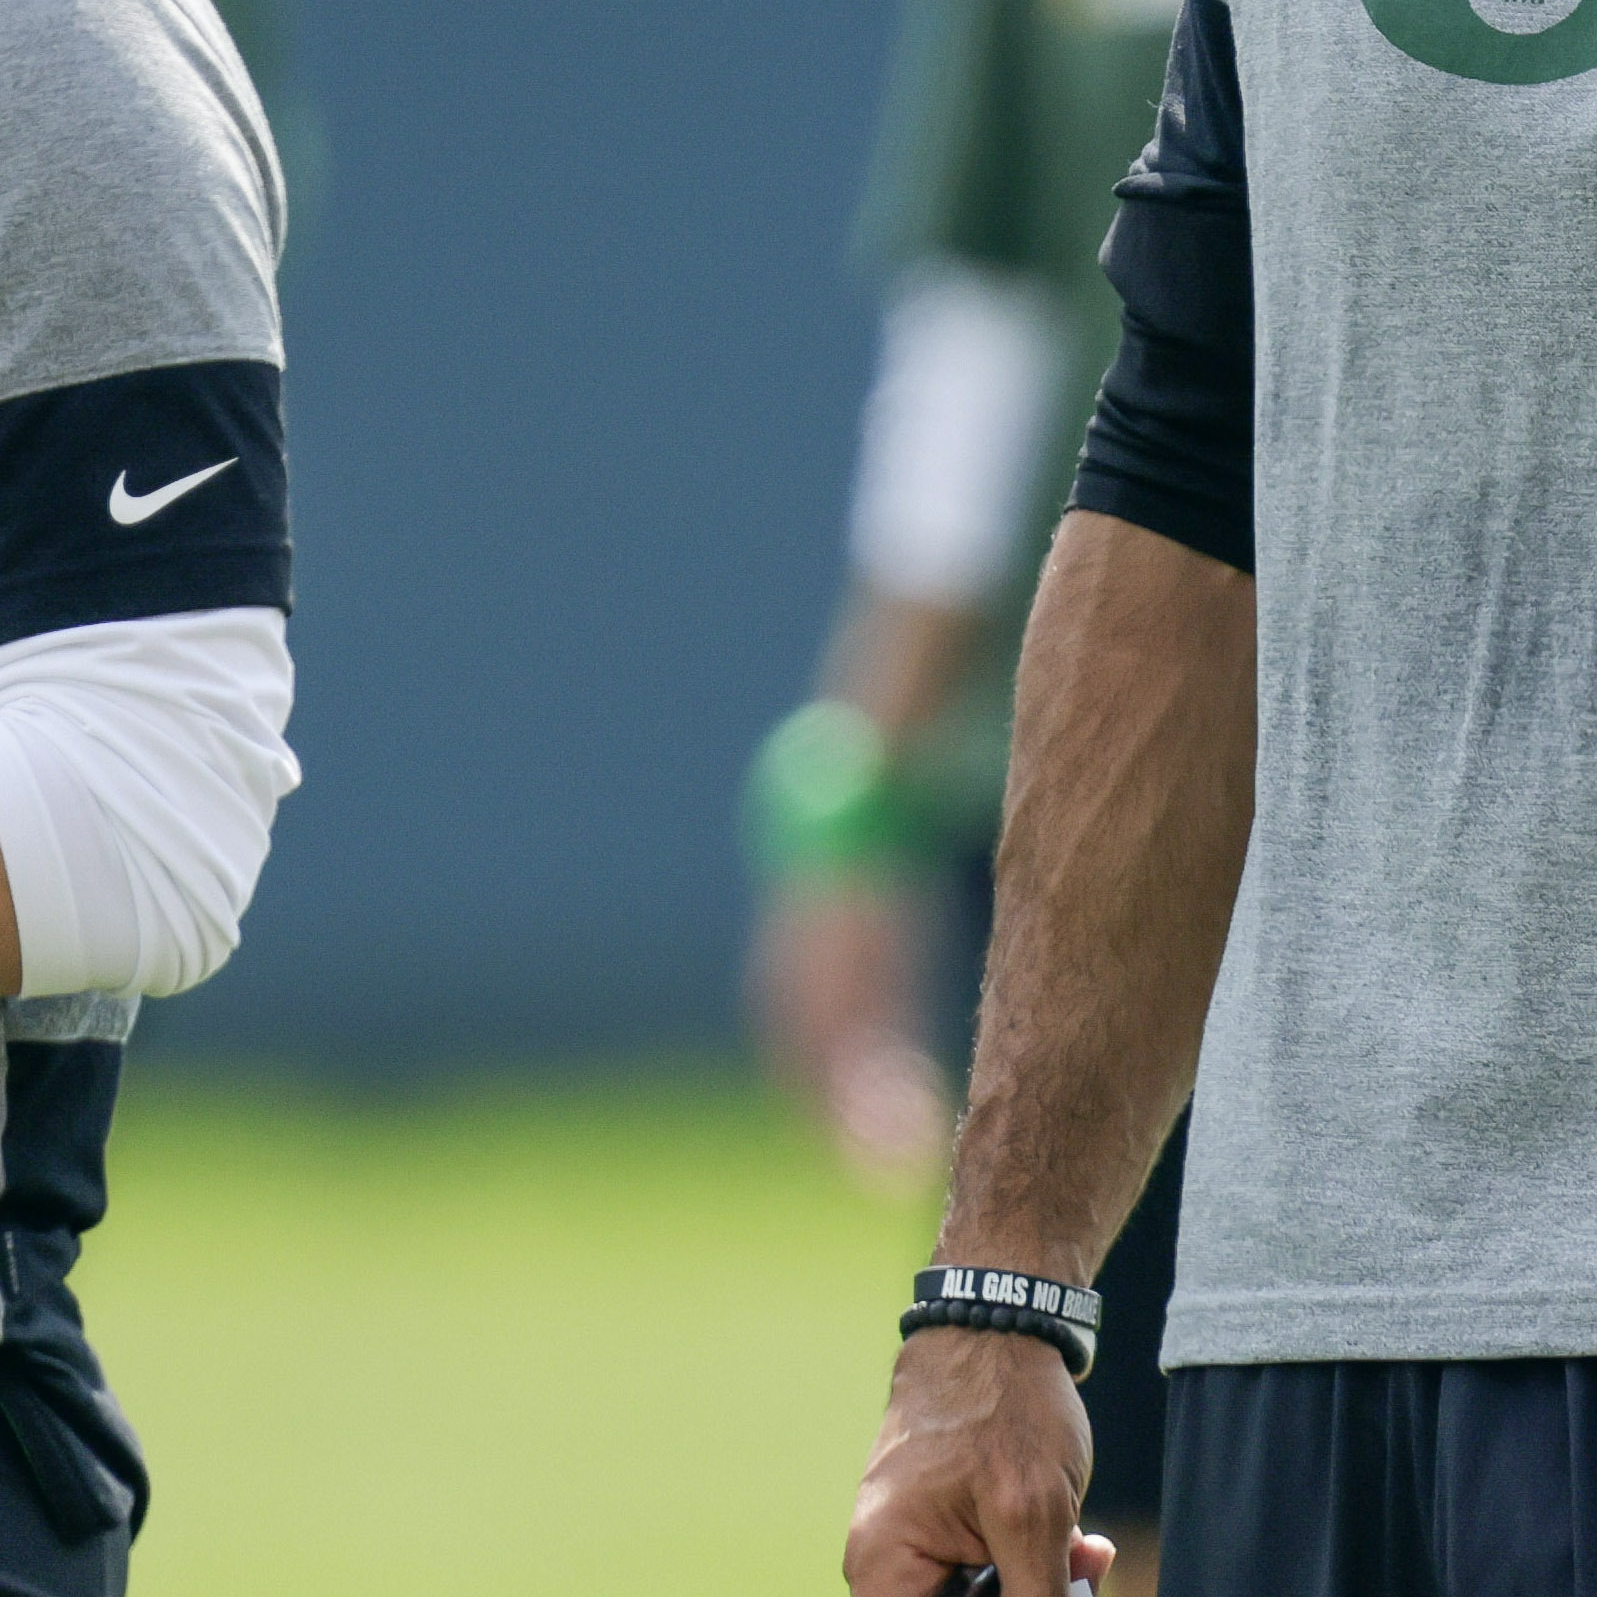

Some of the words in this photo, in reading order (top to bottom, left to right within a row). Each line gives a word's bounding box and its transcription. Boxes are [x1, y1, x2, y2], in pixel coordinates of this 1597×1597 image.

[941, 1268, 976, 1300] ALL
[982, 1271, 1029, 1306] GAS
[1032, 1280, 1061, 1315] NO
